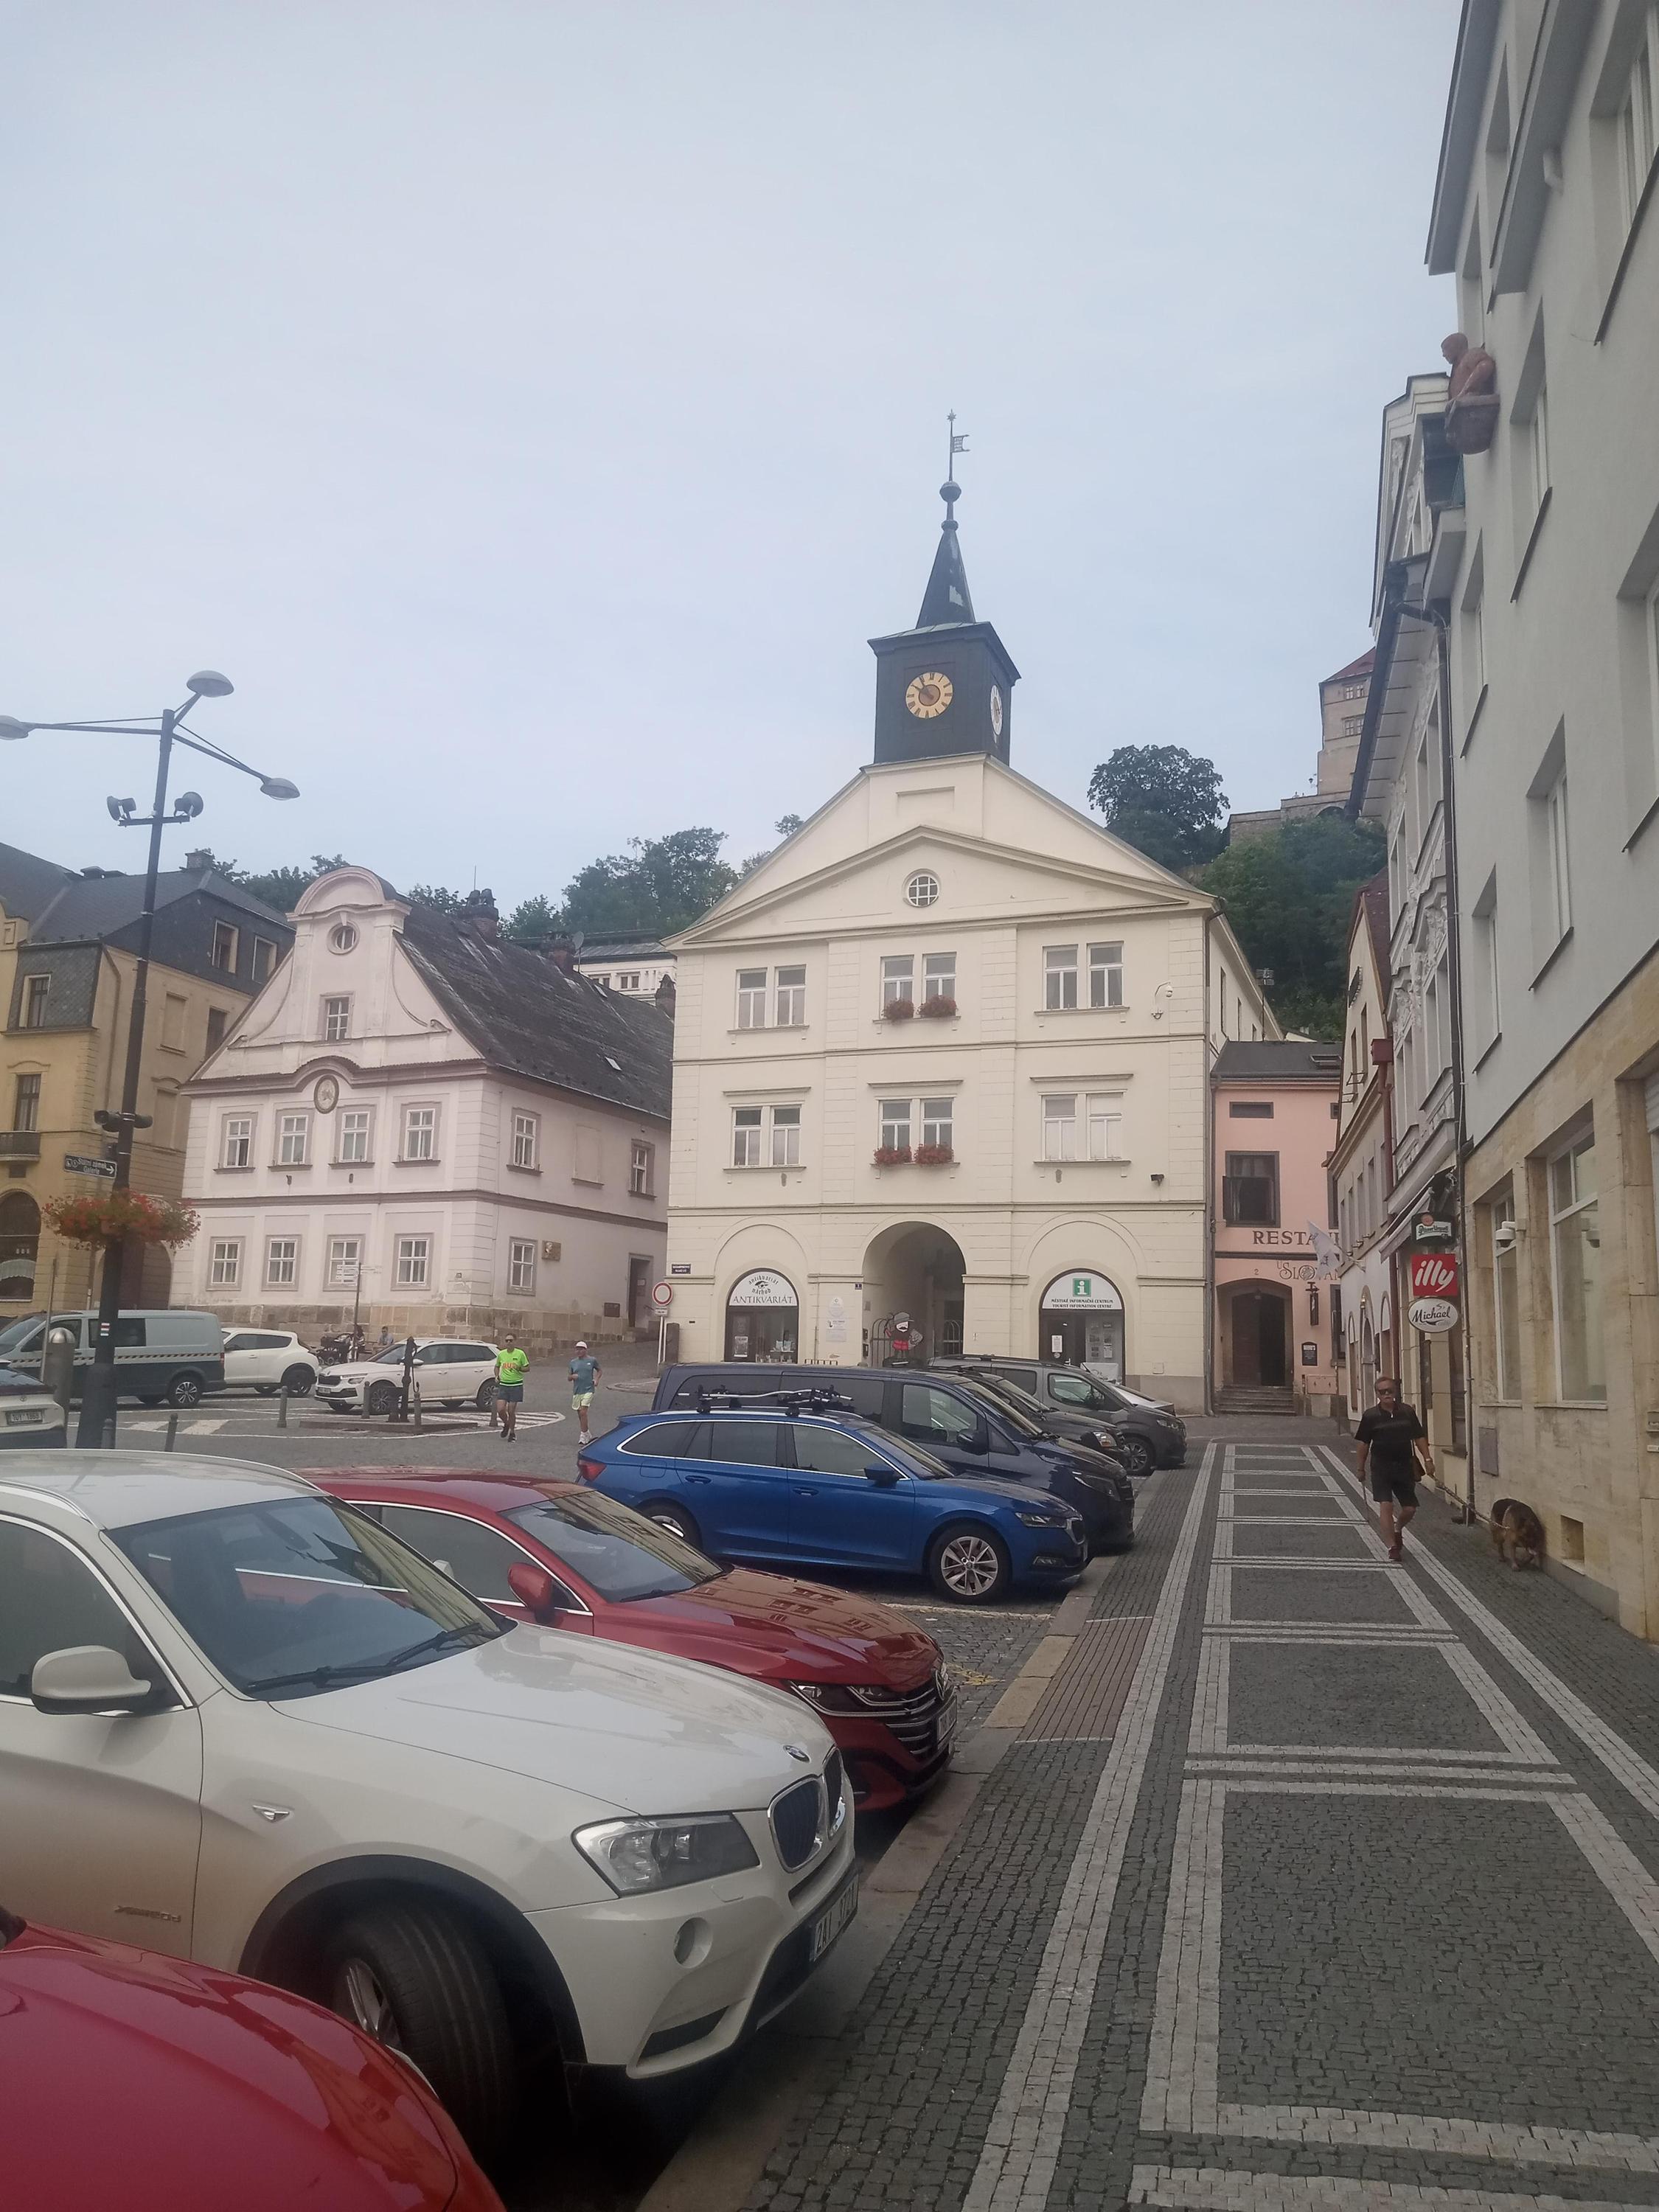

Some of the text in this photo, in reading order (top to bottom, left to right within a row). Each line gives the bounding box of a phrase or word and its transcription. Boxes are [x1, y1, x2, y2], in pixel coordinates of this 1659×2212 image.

[1415, 1259, 1454, 1293] illy
[733, 1295, 793, 1304] ANTIKVARIÁT
[1412, 1306, 1451, 1324] Michael
